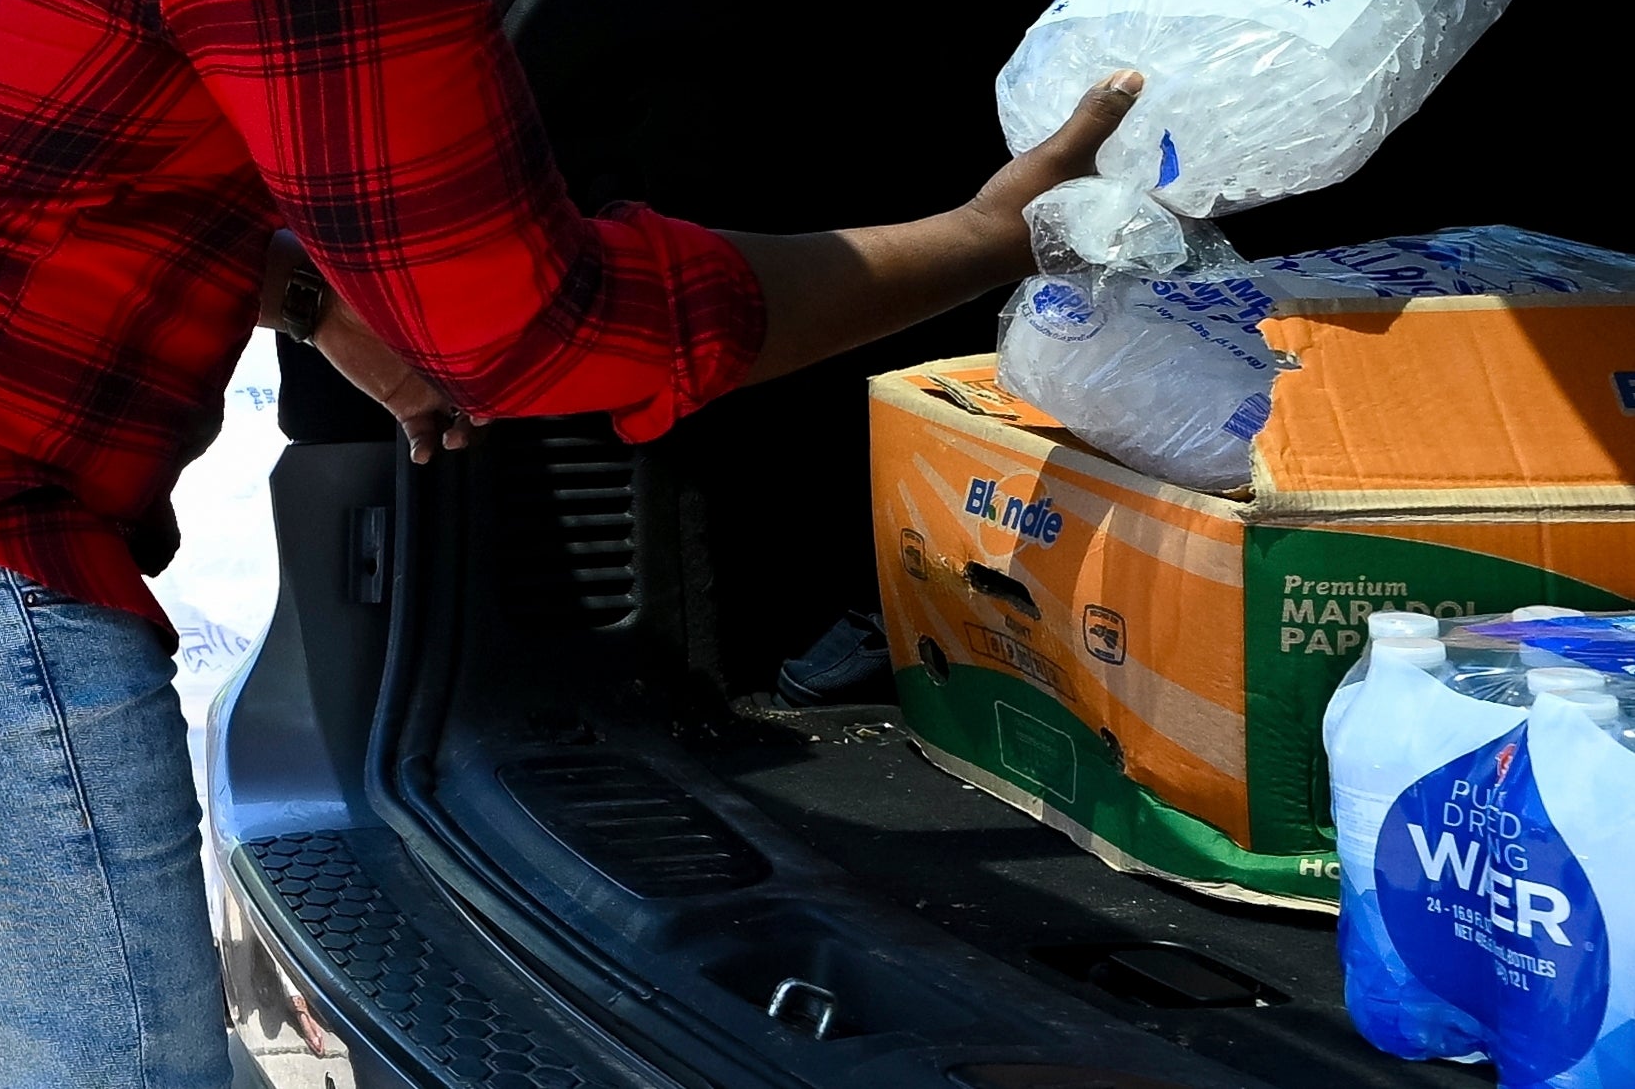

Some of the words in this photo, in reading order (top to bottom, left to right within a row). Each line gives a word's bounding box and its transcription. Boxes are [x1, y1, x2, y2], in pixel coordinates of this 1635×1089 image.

[964, 477, 1064, 545] Blndie
[1284, 575, 1408, 597] Premium
[1280, 627, 1360, 656] PAP
